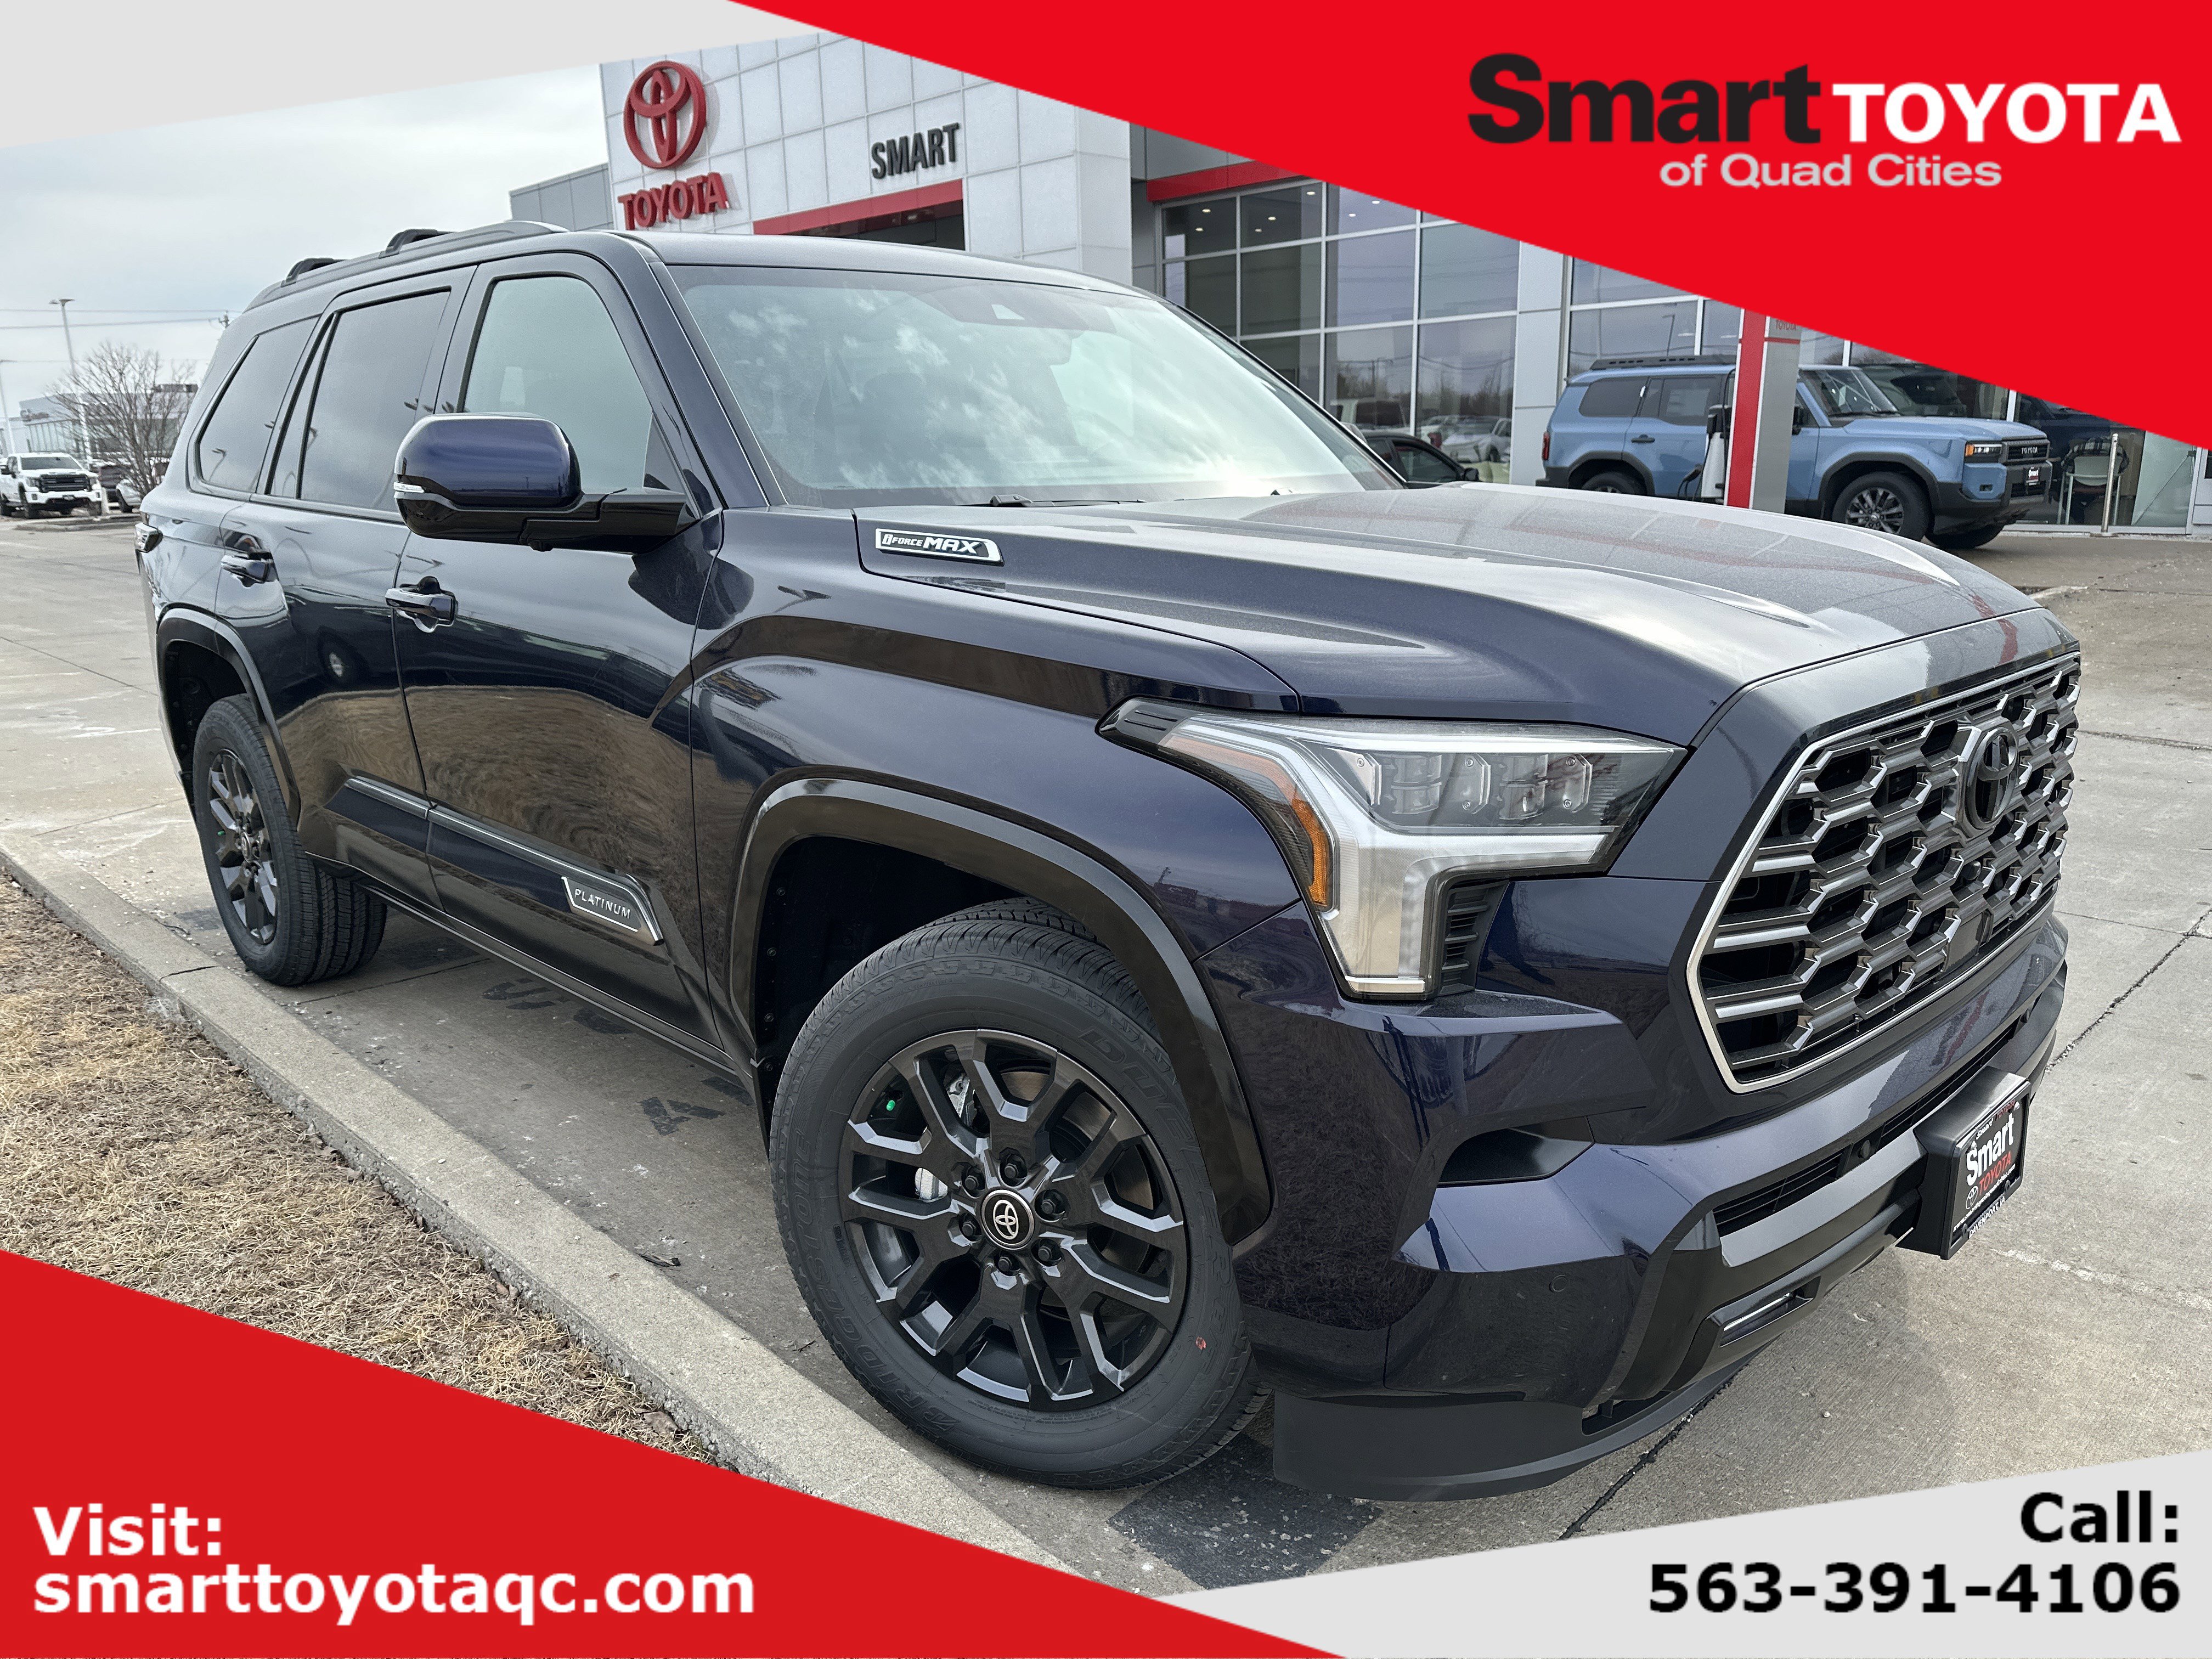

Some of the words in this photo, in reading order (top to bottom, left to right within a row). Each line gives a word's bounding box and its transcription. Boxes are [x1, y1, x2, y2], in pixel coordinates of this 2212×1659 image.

[871, 123, 960, 179] SMART
[618, 172, 729, 230] TOYOTA
[923, 537, 980, 555] MAX
[574, 888, 631, 919] PLATINUM
[1966, 1113, 2015, 1186] Smart
[1979, 1150, 2011, 1195] TOYOTA
[2000, 1196, 2005, 1207] IA
[791, 1127, 961, 1432] BRIDGESTONE
